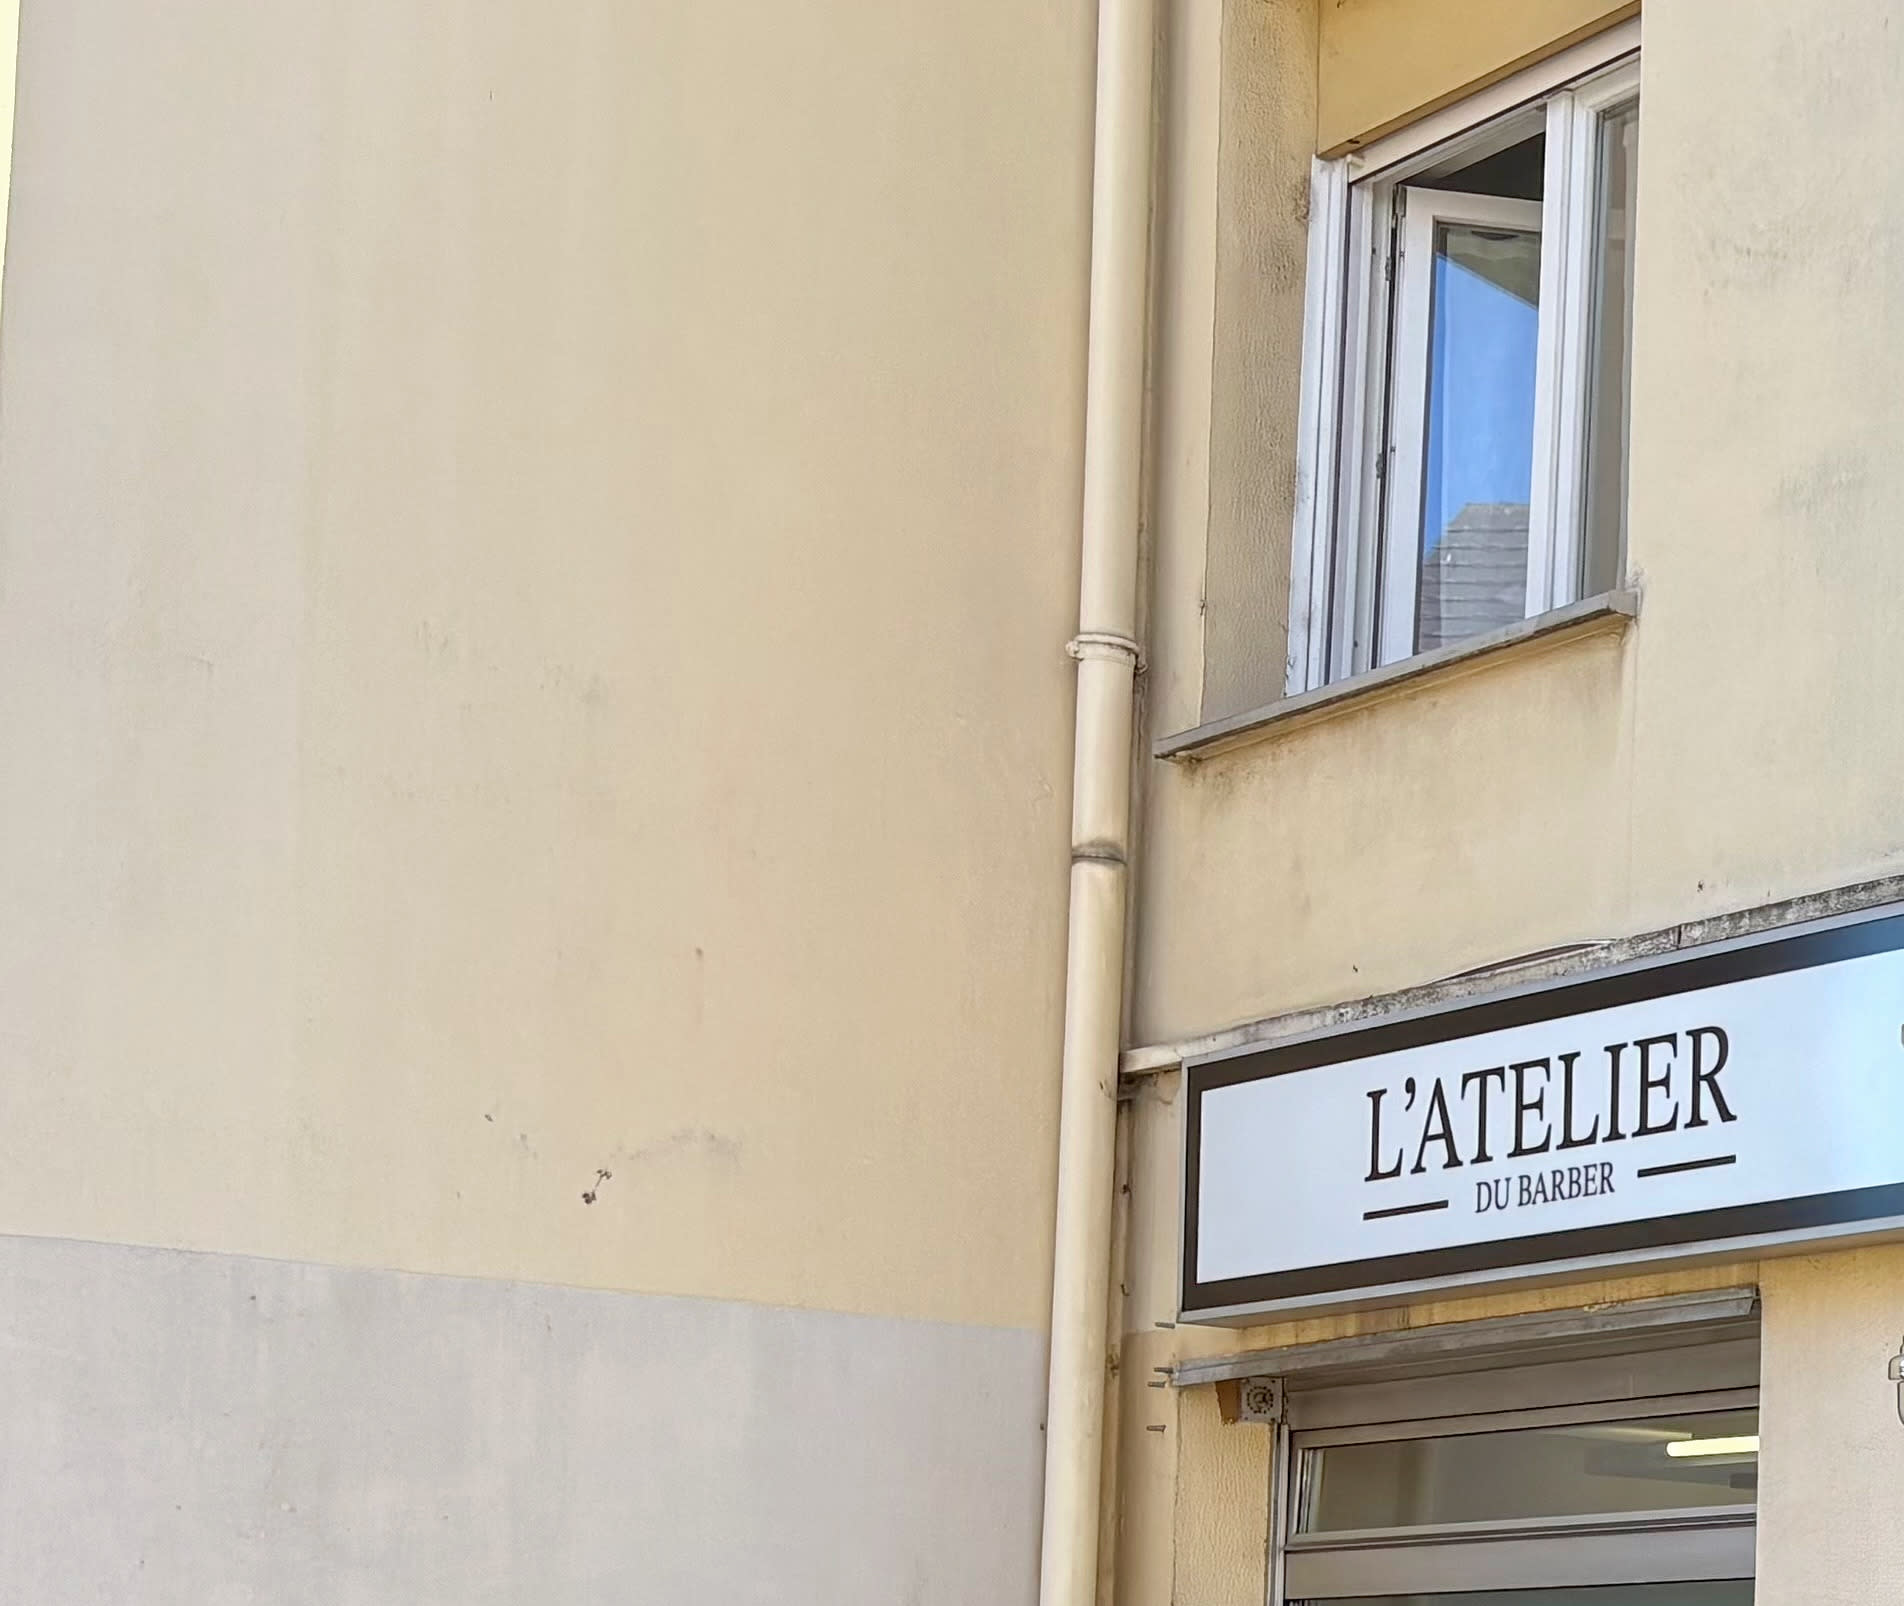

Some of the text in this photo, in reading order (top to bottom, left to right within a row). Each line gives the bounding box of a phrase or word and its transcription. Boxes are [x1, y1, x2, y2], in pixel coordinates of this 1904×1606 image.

[1365, 1026, 1737, 1182] L'ATELIER
[1475, 1161, 1615, 1213] DU BARBER
